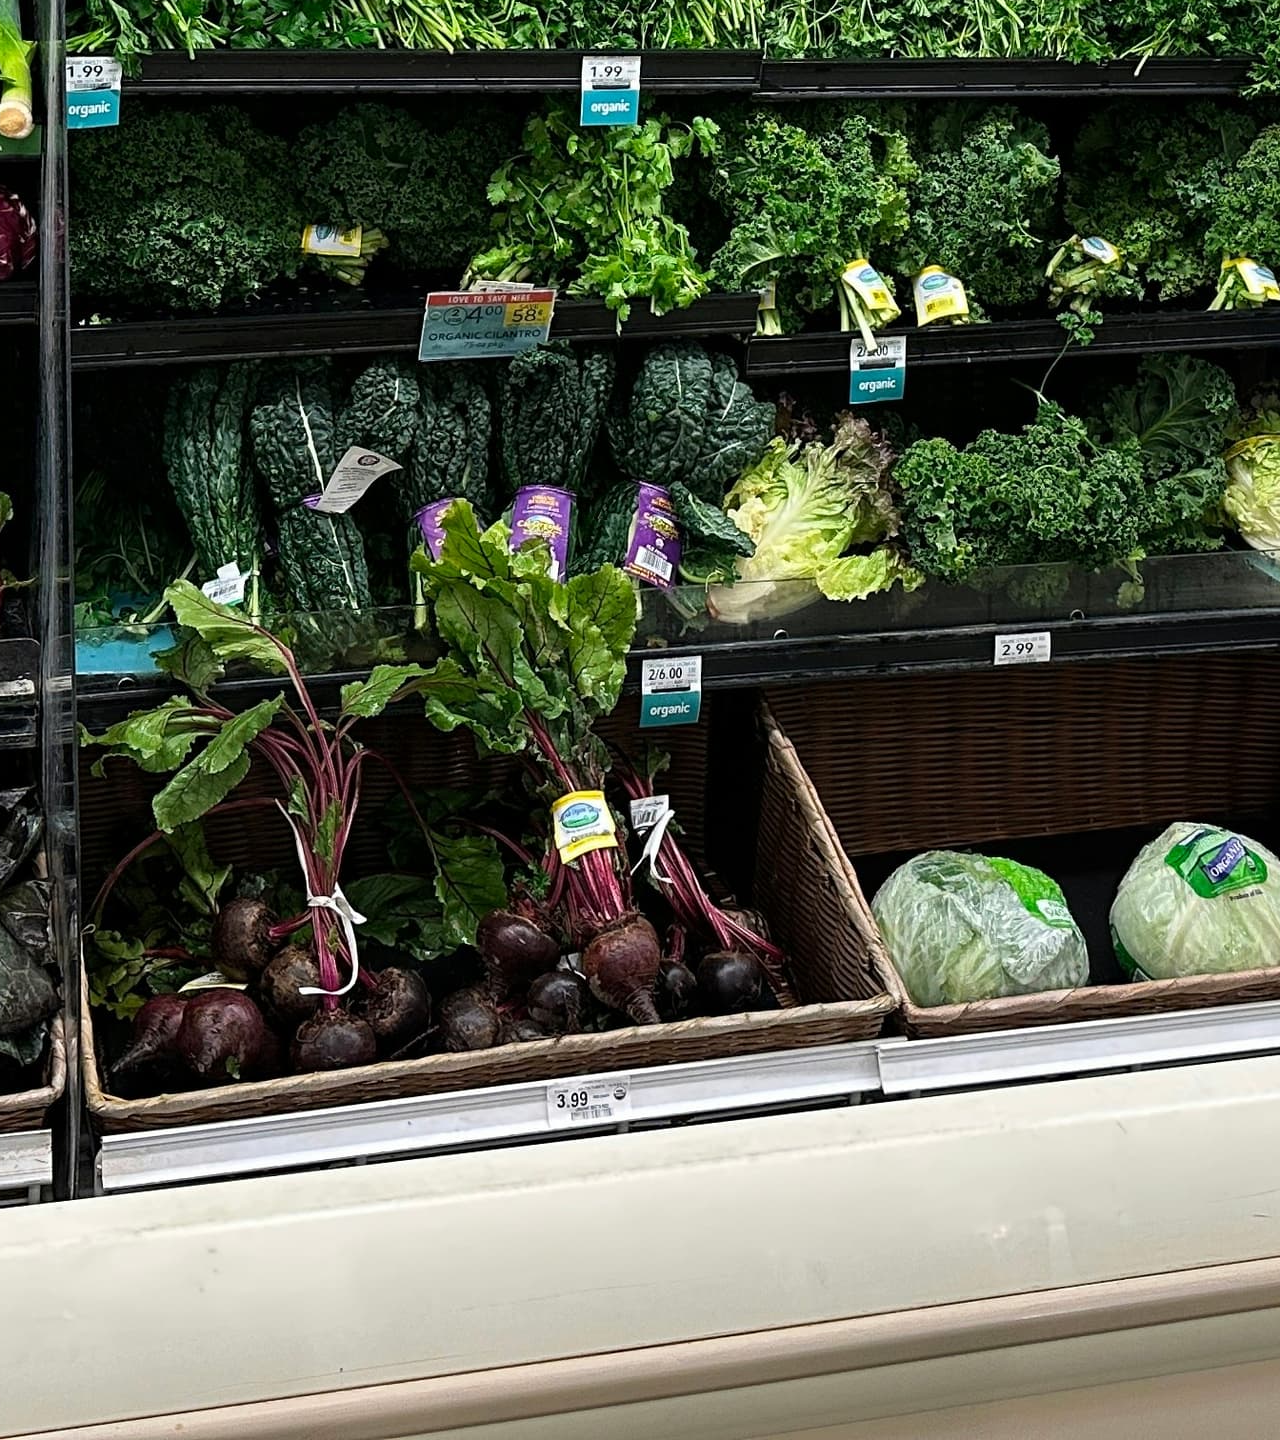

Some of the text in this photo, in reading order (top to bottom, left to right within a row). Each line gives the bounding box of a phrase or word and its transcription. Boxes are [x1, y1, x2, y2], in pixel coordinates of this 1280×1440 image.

[66, 65, 103, 78] 1.99
[590, 65, 623, 78] 1.99
[68, 100, 111, 118] organic
[590, 99, 631, 115] organic
[448, 296, 469, 304] LOVE
[472, 295, 483, 303] TO
[487, 295, 507, 303] SAVE
[451, 309, 459, 317] 2
[428, 329, 542, 342] ORGANIC CILANTRO
[858, 377, 897, 393] organic
[1002, 642, 1034, 656] 2.99
[648, 667, 683, 681] 2/6.00
[650, 702, 691, 718] organic
[556, 1091, 588, 1110] 3.99
